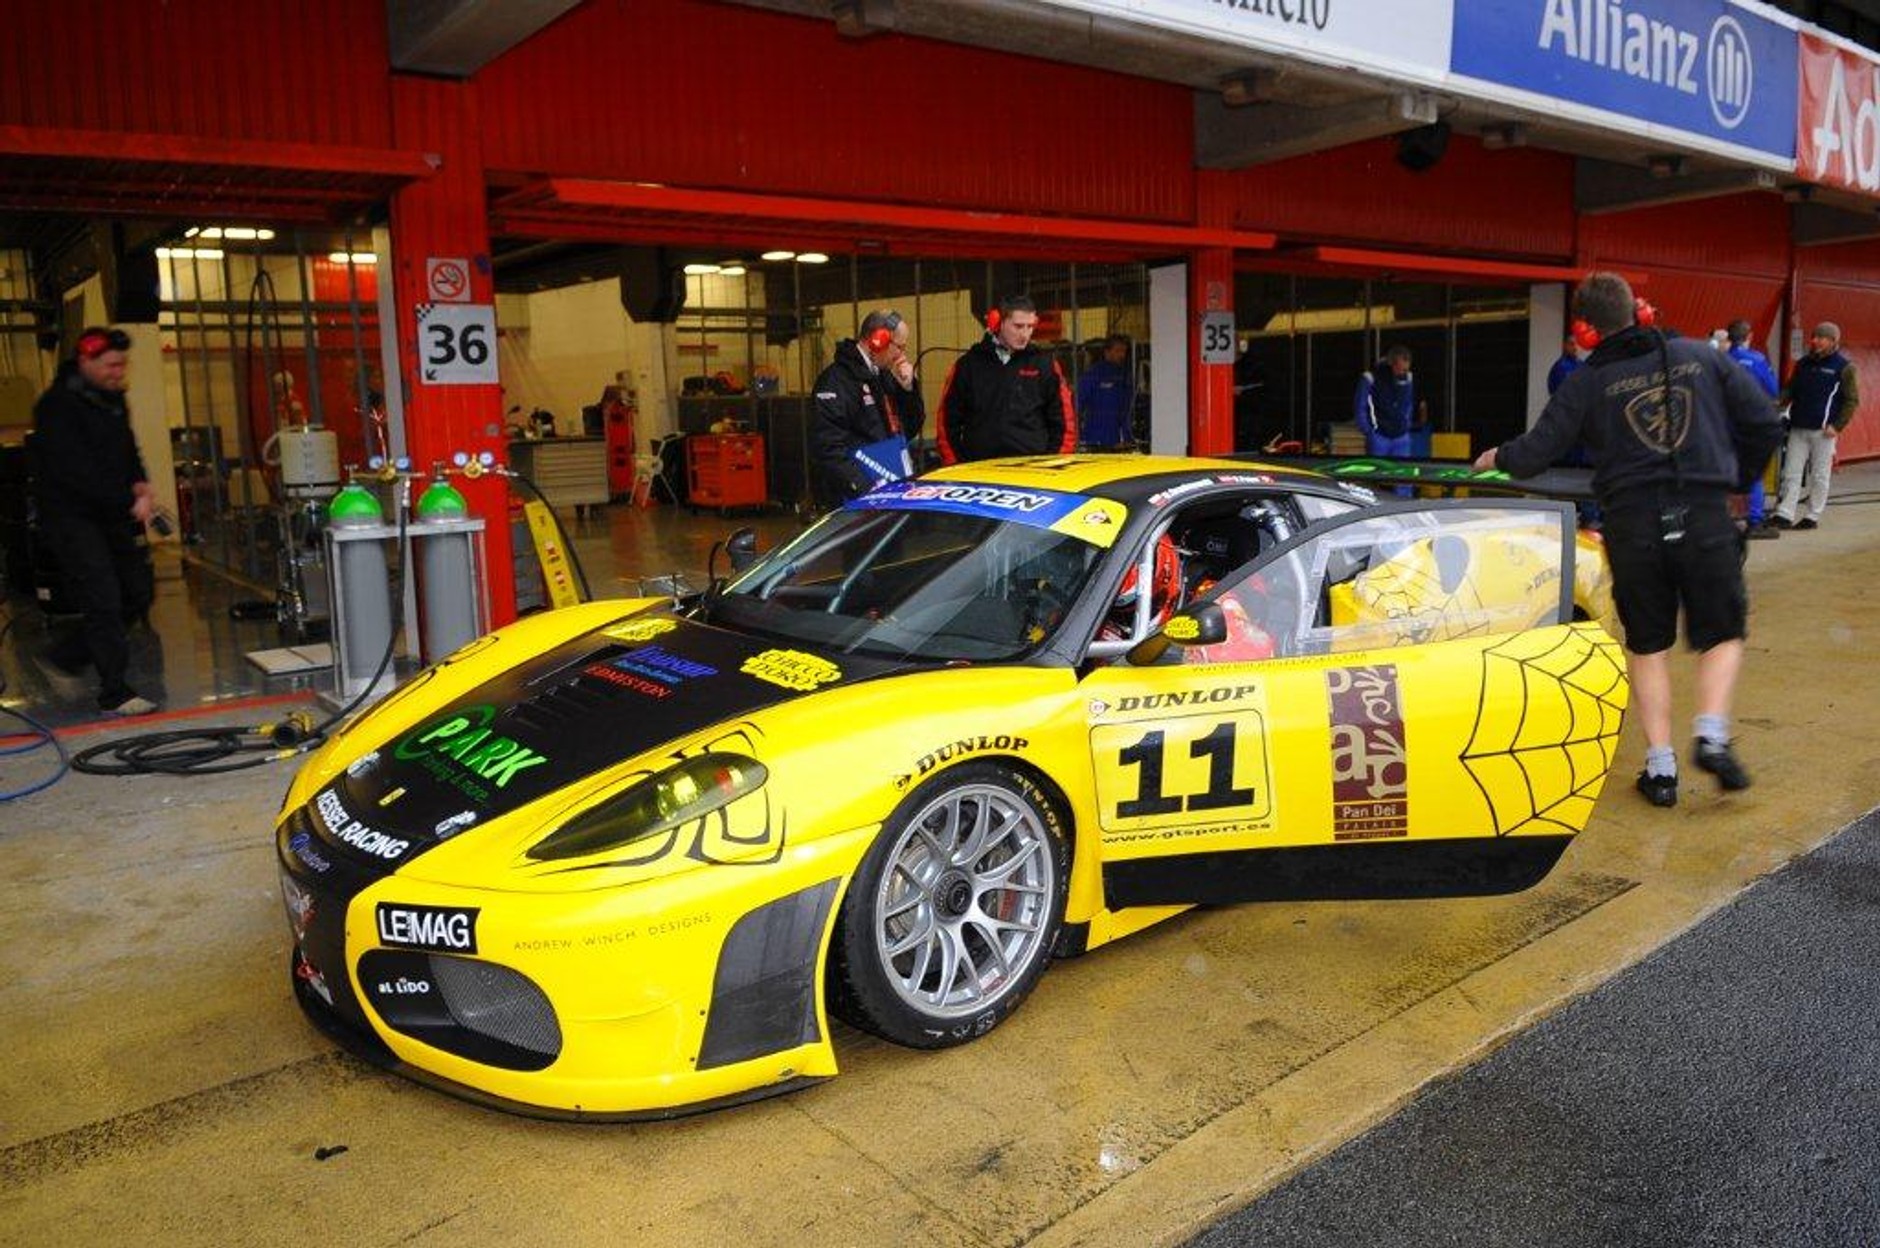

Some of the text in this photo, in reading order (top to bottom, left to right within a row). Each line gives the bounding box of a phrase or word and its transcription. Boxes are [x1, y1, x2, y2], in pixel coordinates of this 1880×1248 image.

[1539, 0, 1698, 95] Allianz
[428, 324, 488, 365] 36
[1205, 324, 1231, 351] 35
[1116, 685, 1256, 712] DUNLOP
[916, 735, 1029, 776] DUNLOP
[1117, 722, 1255, 819] 11
[1342, 806, 1369, 818] Pan
[339, 821, 409, 859] RACING
[1102, 822, 1271, 844] www.gtsport.es
[514, 912, 711, 951] ANDREW WINCH DESIGNS
